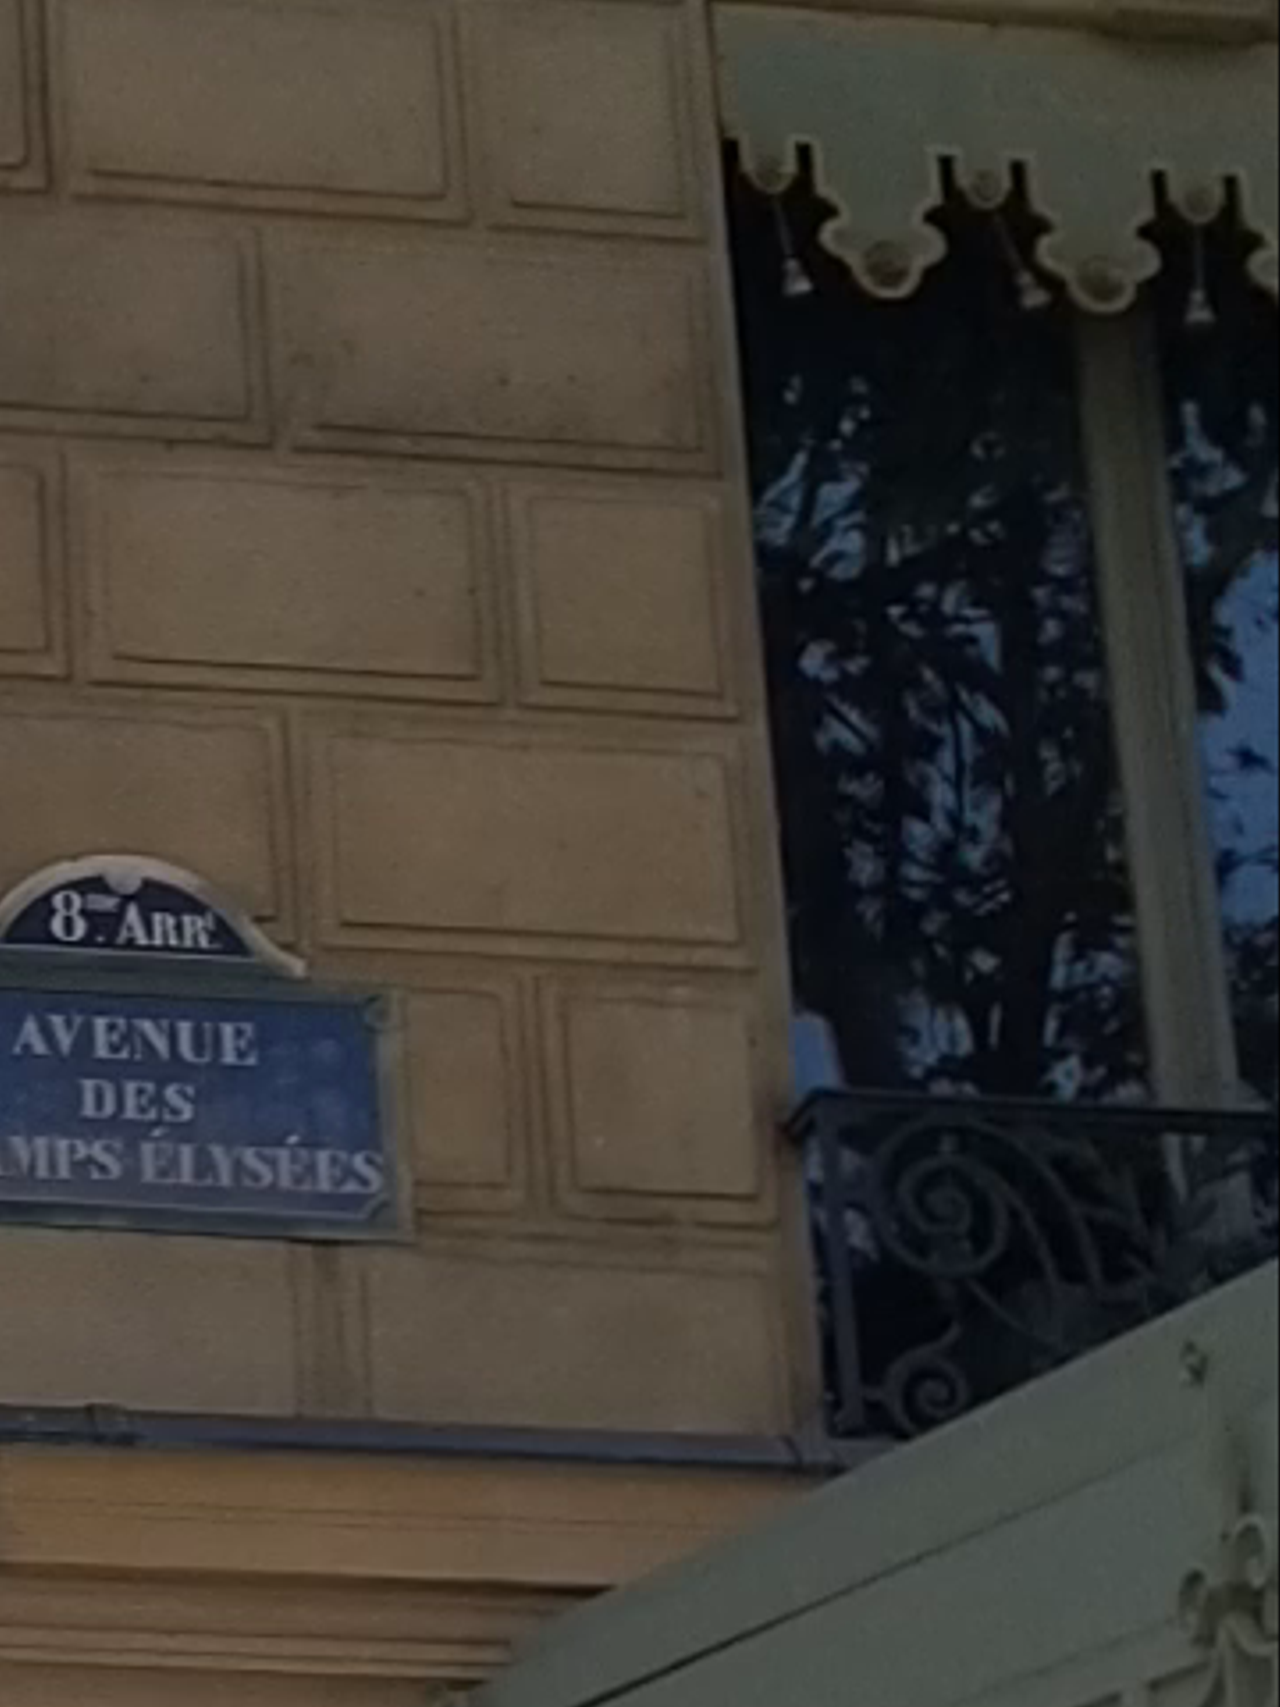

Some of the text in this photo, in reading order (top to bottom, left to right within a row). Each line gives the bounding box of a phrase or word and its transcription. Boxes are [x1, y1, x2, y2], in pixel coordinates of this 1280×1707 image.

[12, 1013, 259, 1065] AVENUE
[80, 1078, 196, 1123] DES
[139, 1126, 385, 1194] ÉLYSÉES
